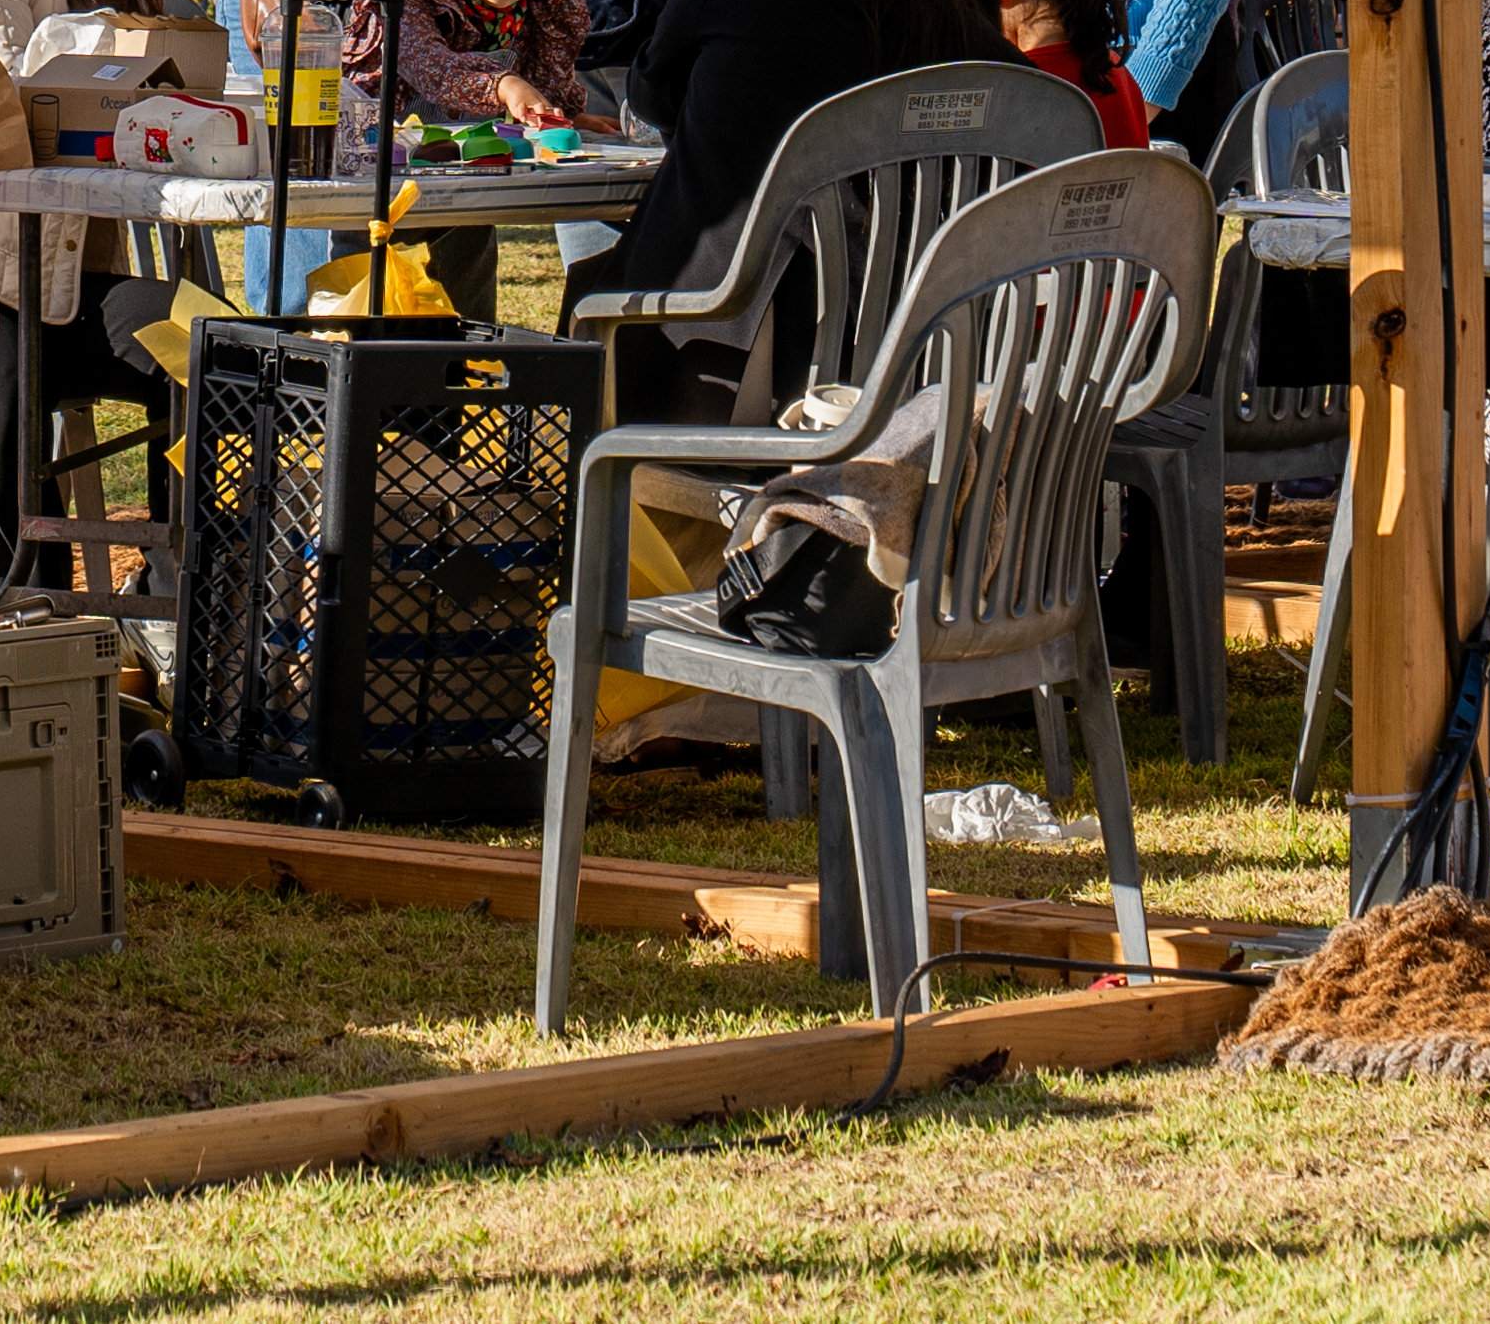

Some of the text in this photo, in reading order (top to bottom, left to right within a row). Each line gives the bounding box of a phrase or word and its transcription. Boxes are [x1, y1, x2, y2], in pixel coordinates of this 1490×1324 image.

[908, 92, 986, 111] 현대종합렌탈
[919, 111, 935, 120] 051)
[918, 119, 971, 130] 055) 742-6230
[1061, 182, 1128, 206] 현대종합렌탈
